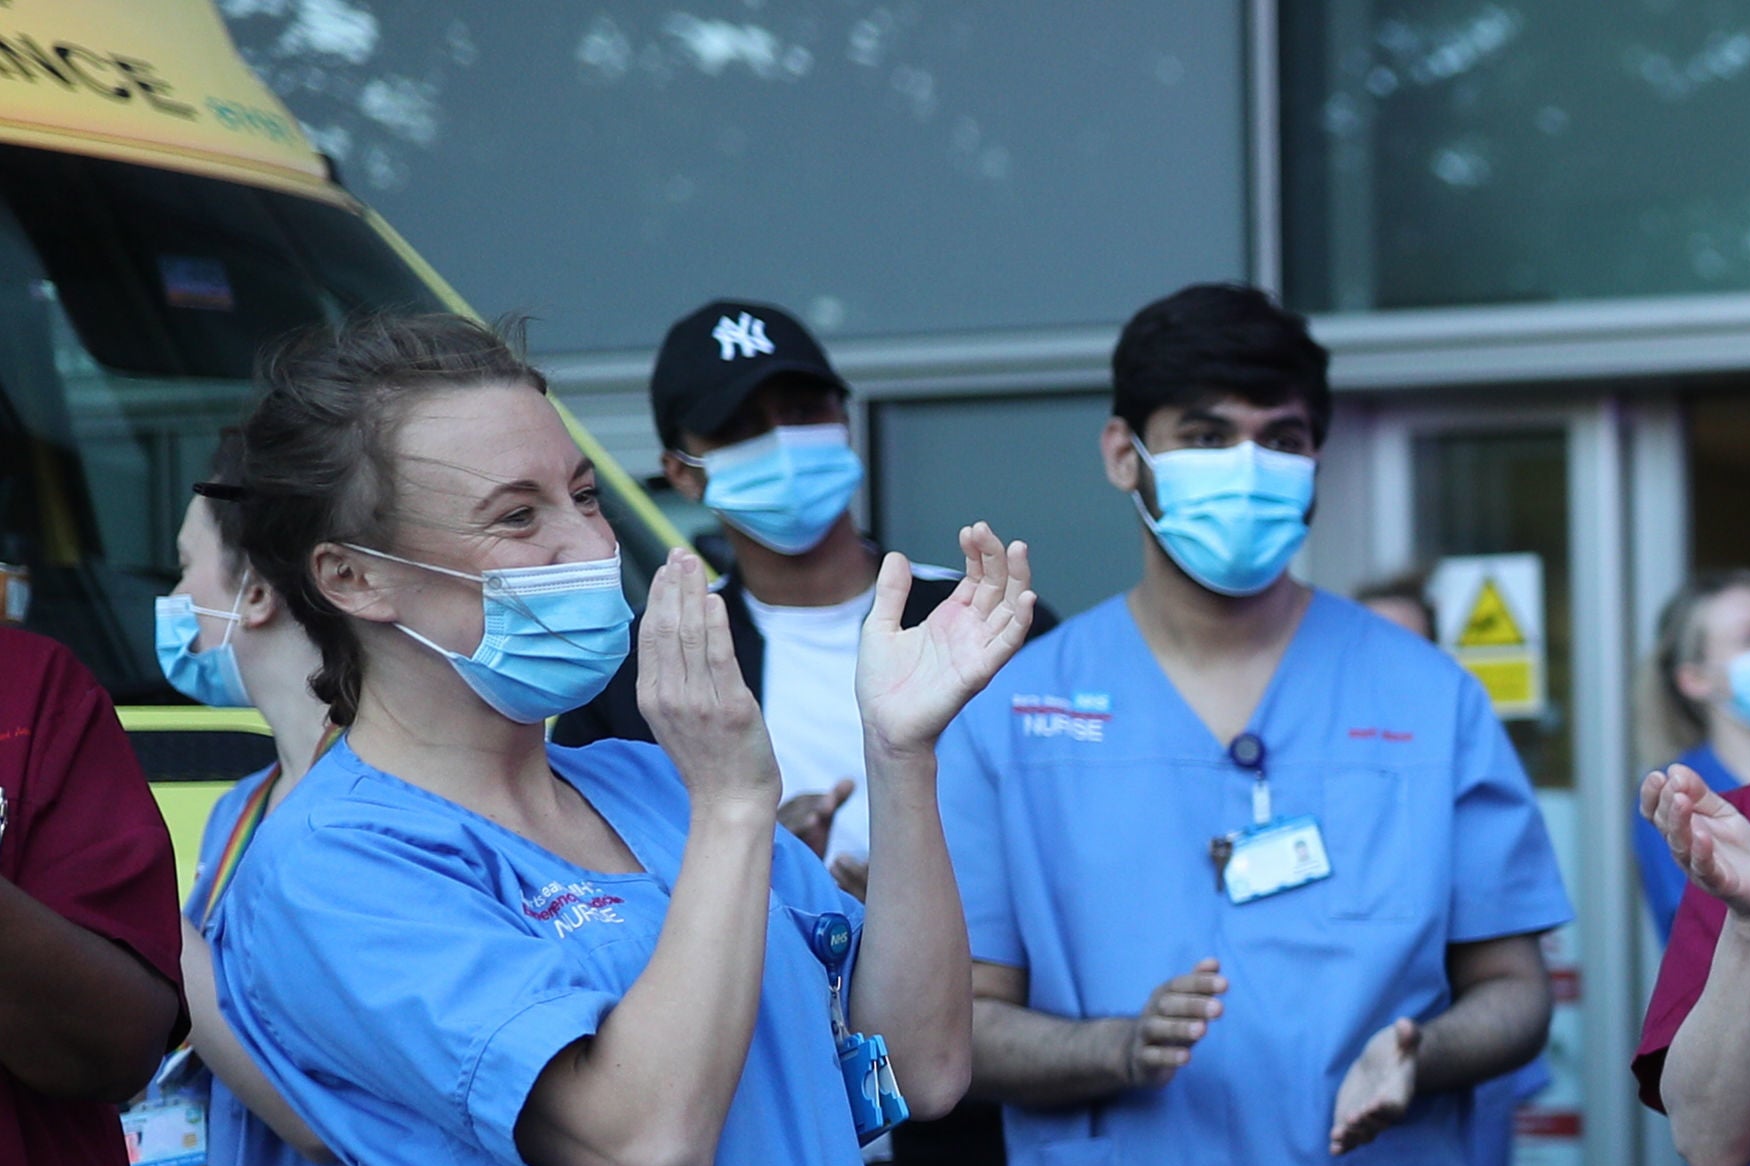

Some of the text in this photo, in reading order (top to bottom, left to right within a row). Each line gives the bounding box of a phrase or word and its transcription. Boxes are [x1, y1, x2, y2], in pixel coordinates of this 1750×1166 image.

[712, 311, 776, 361] NY
[1024, 714, 1104, 743] NURSE
[830, 931, 849, 947] NHS
